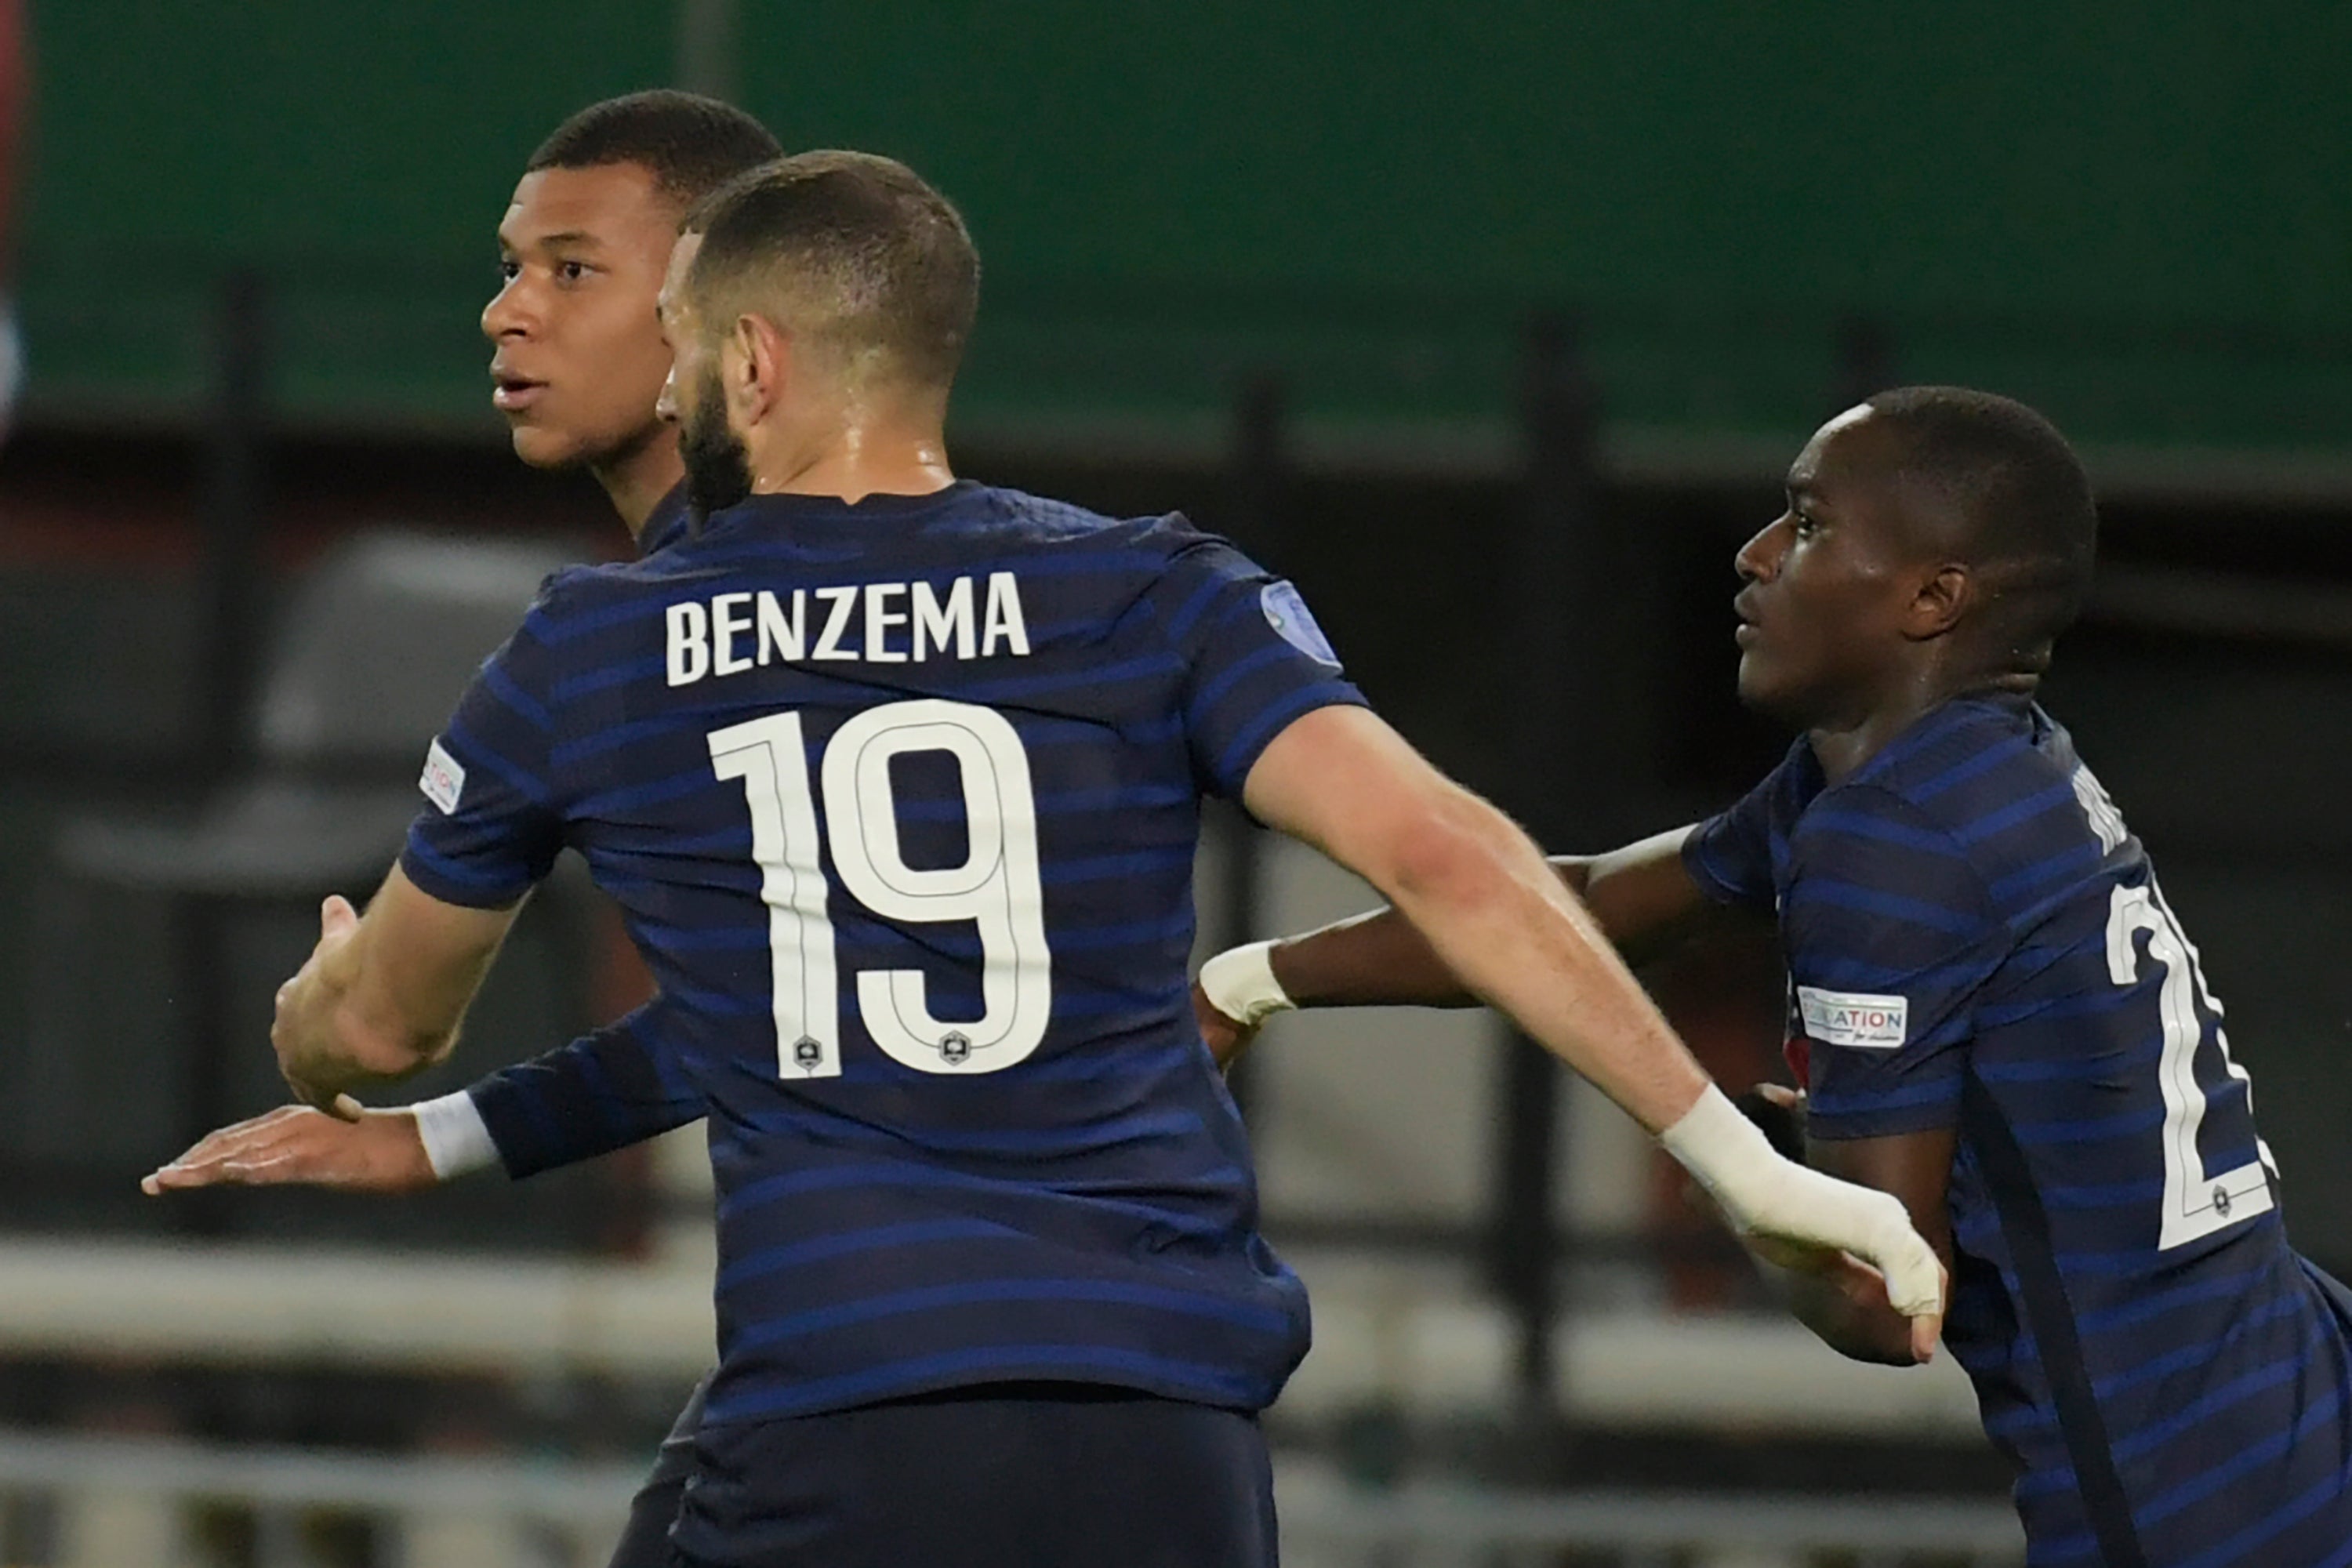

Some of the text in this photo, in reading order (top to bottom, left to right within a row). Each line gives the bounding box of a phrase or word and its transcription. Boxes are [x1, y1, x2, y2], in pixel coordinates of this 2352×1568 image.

[666, 572, 1030, 687] BENZEMA
[707, 699, 1051, 1080] 19
[1819, 1007, 1902, 1029] ATION
[2107, 872, 2280, 1251] 2
